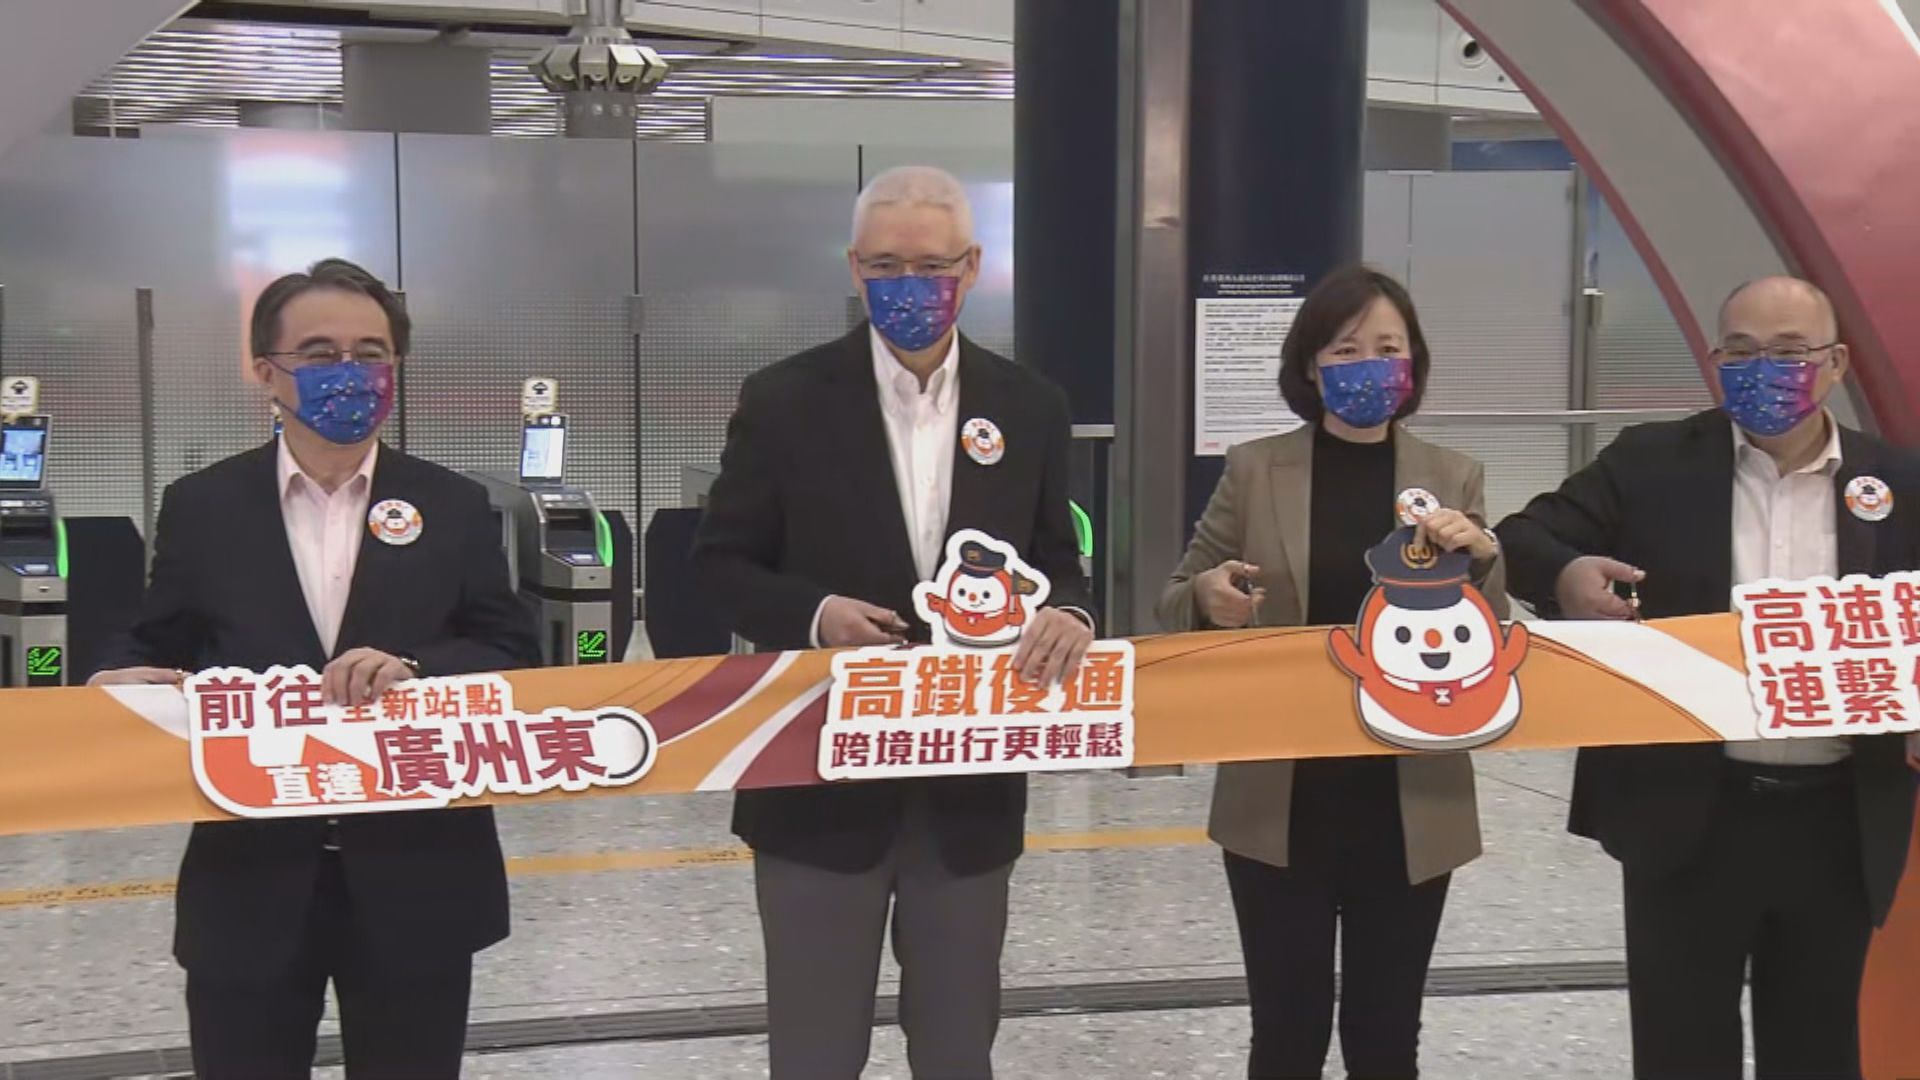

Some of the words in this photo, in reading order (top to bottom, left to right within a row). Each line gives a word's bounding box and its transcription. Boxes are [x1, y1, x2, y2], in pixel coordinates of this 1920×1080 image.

[195, 675, 327, 730] 前往
[1758, 655, 1920, 729] 連繫
[374, 716, 606, 791] 廣州東
[831, 722, 1123, 768] 跨境出行更輕鬆
[266, 762, 368, 805] 直達
